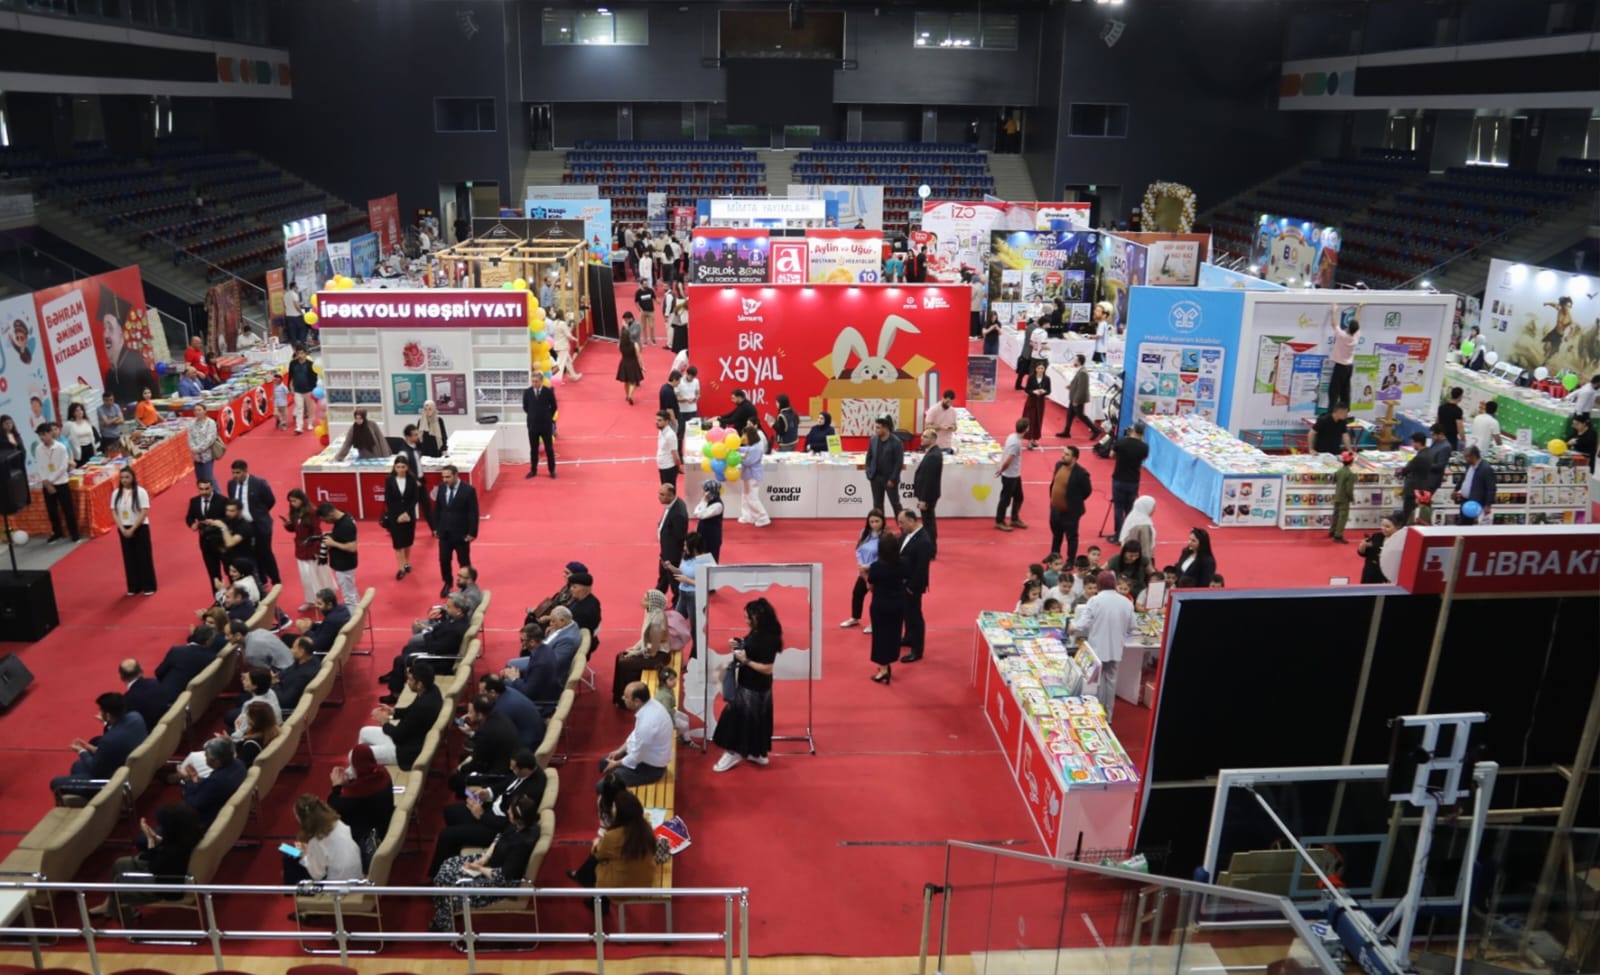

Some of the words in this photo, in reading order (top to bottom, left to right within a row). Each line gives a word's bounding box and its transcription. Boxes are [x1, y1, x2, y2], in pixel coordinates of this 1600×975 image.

[815, 243, 839, 255] Aylin
[851, 243, 873, 256] Uğur
[862, 272, 873, 282] 10
[45, 300, 84, 329] BƏHRAM
[321, 301, 410, 318] İPƏKYOLU
[414, 300, 522, 321] NƏŞRİYYATI
[56, 319, 83, 344] ƏMİNİN
[738, 331, 764, 352] BİR
[54, 336, 92, 365] KİTABLARI
[718, 355, 784, 386] XƏYAL
[1465, 549, 1562, 577] LiBRA
